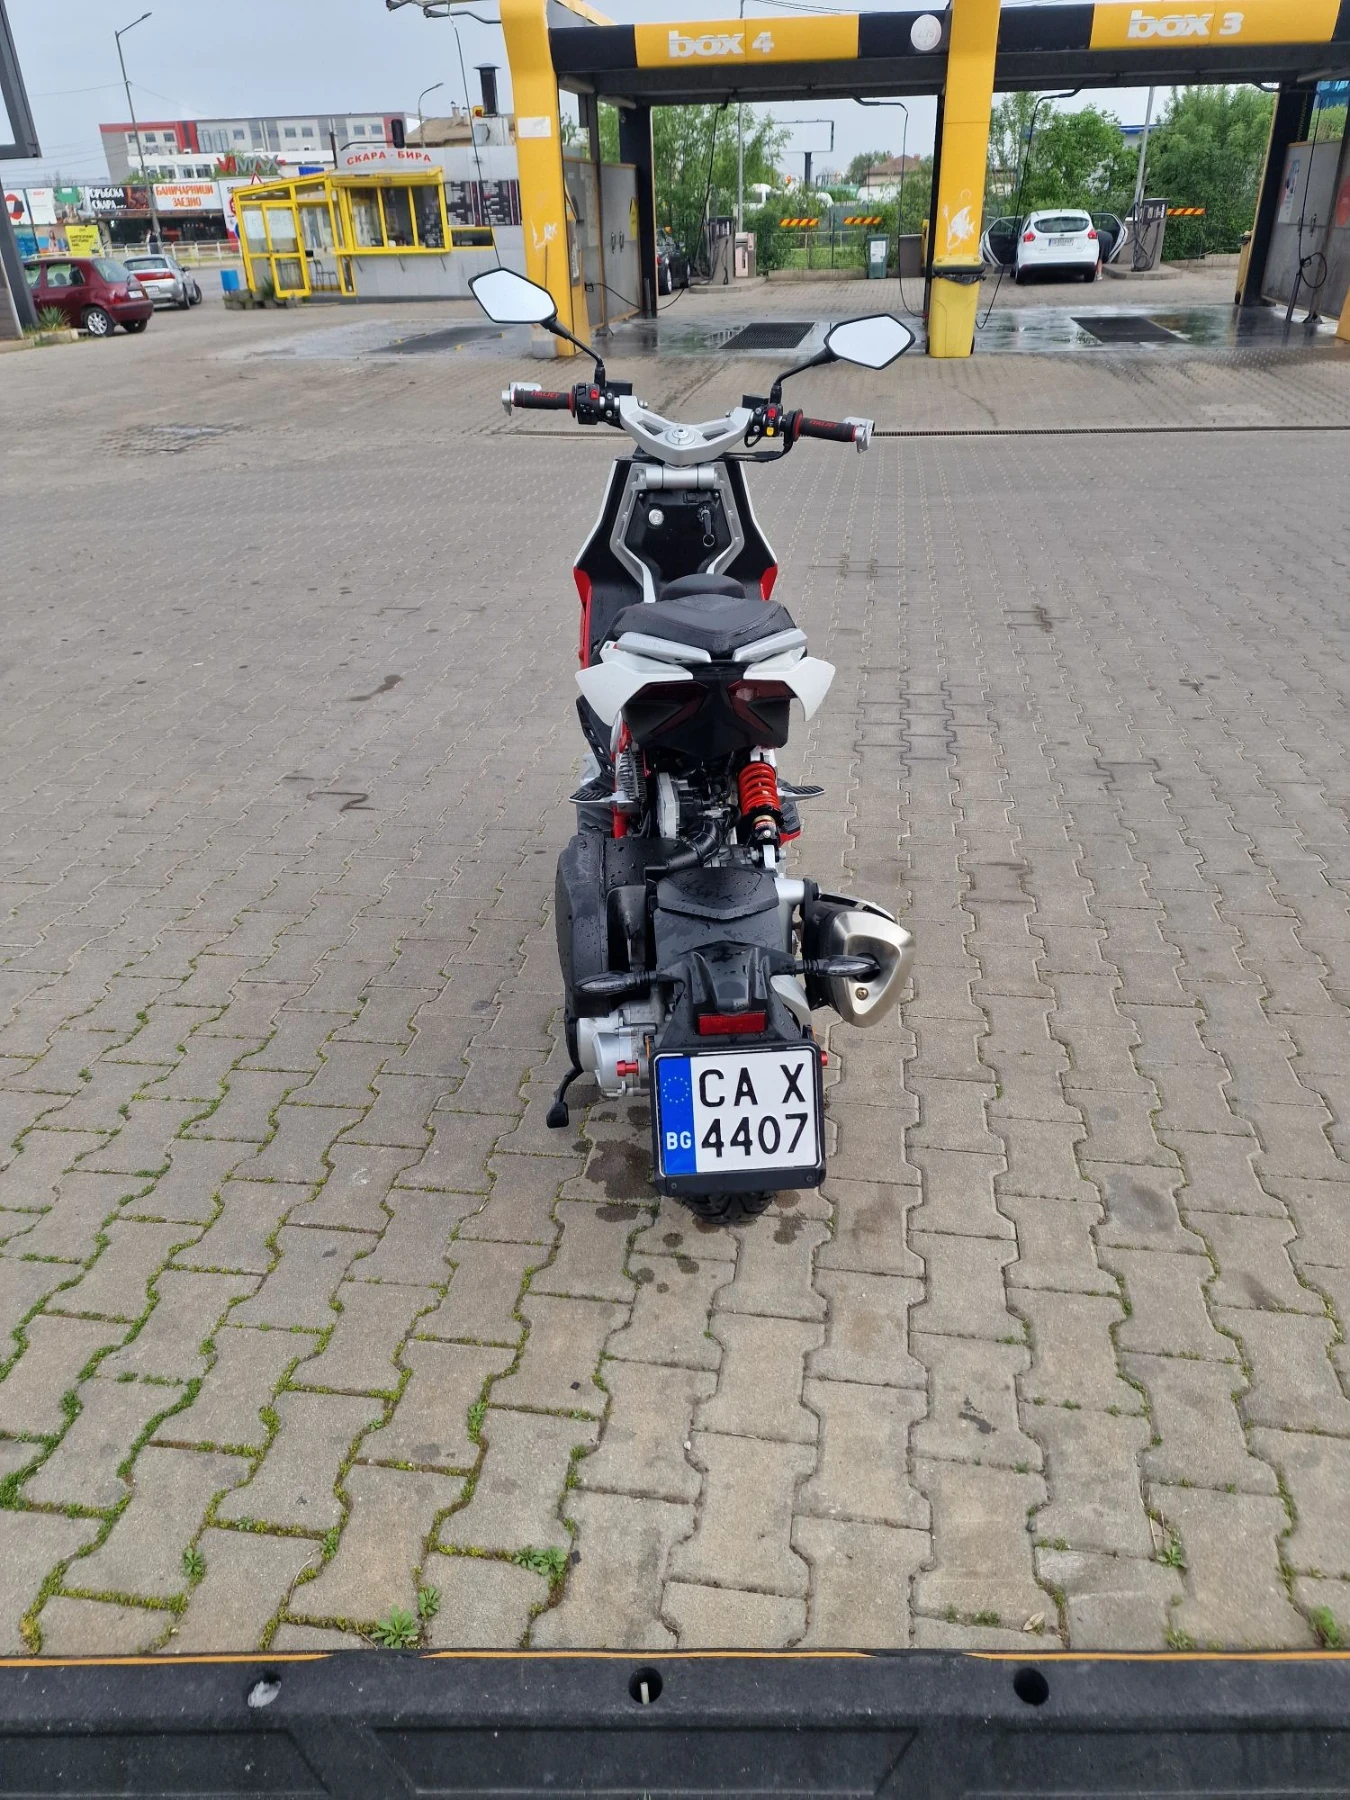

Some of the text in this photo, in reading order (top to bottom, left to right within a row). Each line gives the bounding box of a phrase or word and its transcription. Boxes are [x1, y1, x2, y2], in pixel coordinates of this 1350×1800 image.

[1127, 9, 1245, 39] box 3
[668, 31, 775, 58] box 4
[346, 150, 387, 166] СКАРА
[397, 150, 432, 163] БИРА
[698, 1063, 806, 1108] CA X
[665, 1131, 692, 1150] BG
[701, 1112, 809, 1158] 4407
